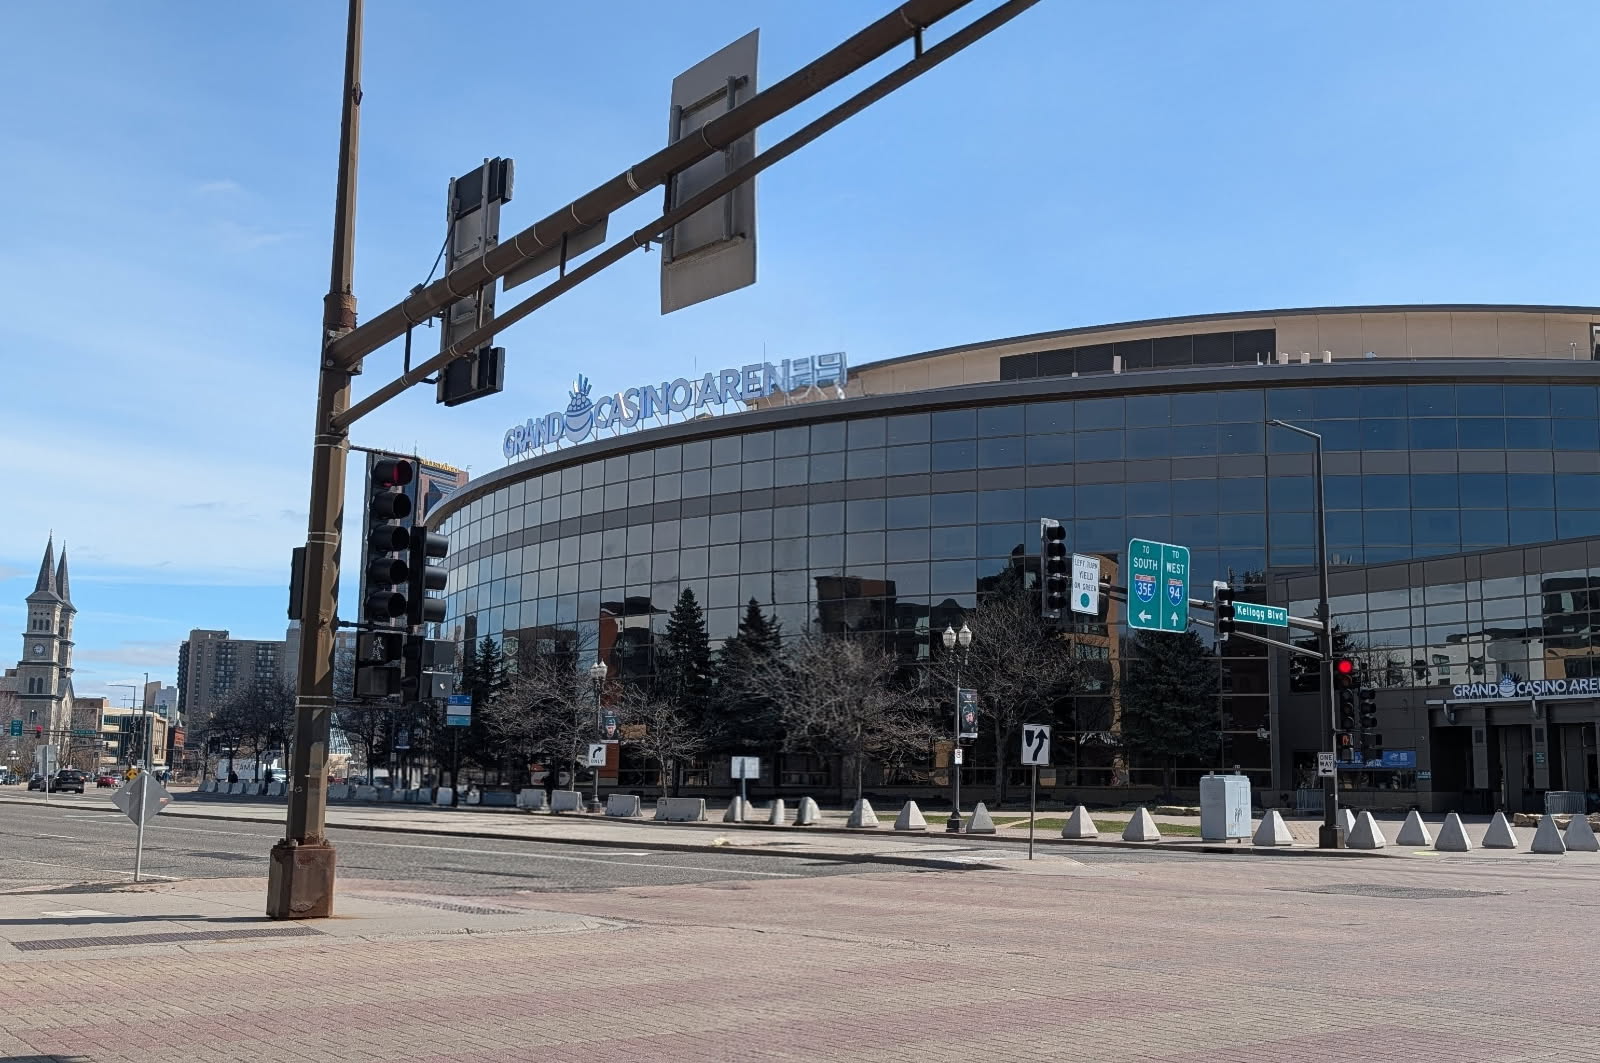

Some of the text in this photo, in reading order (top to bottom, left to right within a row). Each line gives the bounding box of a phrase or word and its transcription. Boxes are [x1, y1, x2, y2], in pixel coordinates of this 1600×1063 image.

[503, 411, 565, 459] GRAND
[594, 377, 693, 430] CASINO
[1142, 544, 1150, 554] TO
[1172, 550, 1180, 559] TO
[1074, 558, 1098, 569] LEFT TURN
[1133, 557, 1158, 571] SOUTH
[1166, 562, 1185, 575] WEST
[1079, 570, 1094, 581] YIELD
[1074, 581, 1097, 592] ON GREEN
[1137, 582, 1153, 597] 35E
[1169, 586, 1180, 600] 94
[1237, 605, 1284, 621] Kellogg Blvd
[1453, 677, 1600, 697] GRAND CASINO ARE
